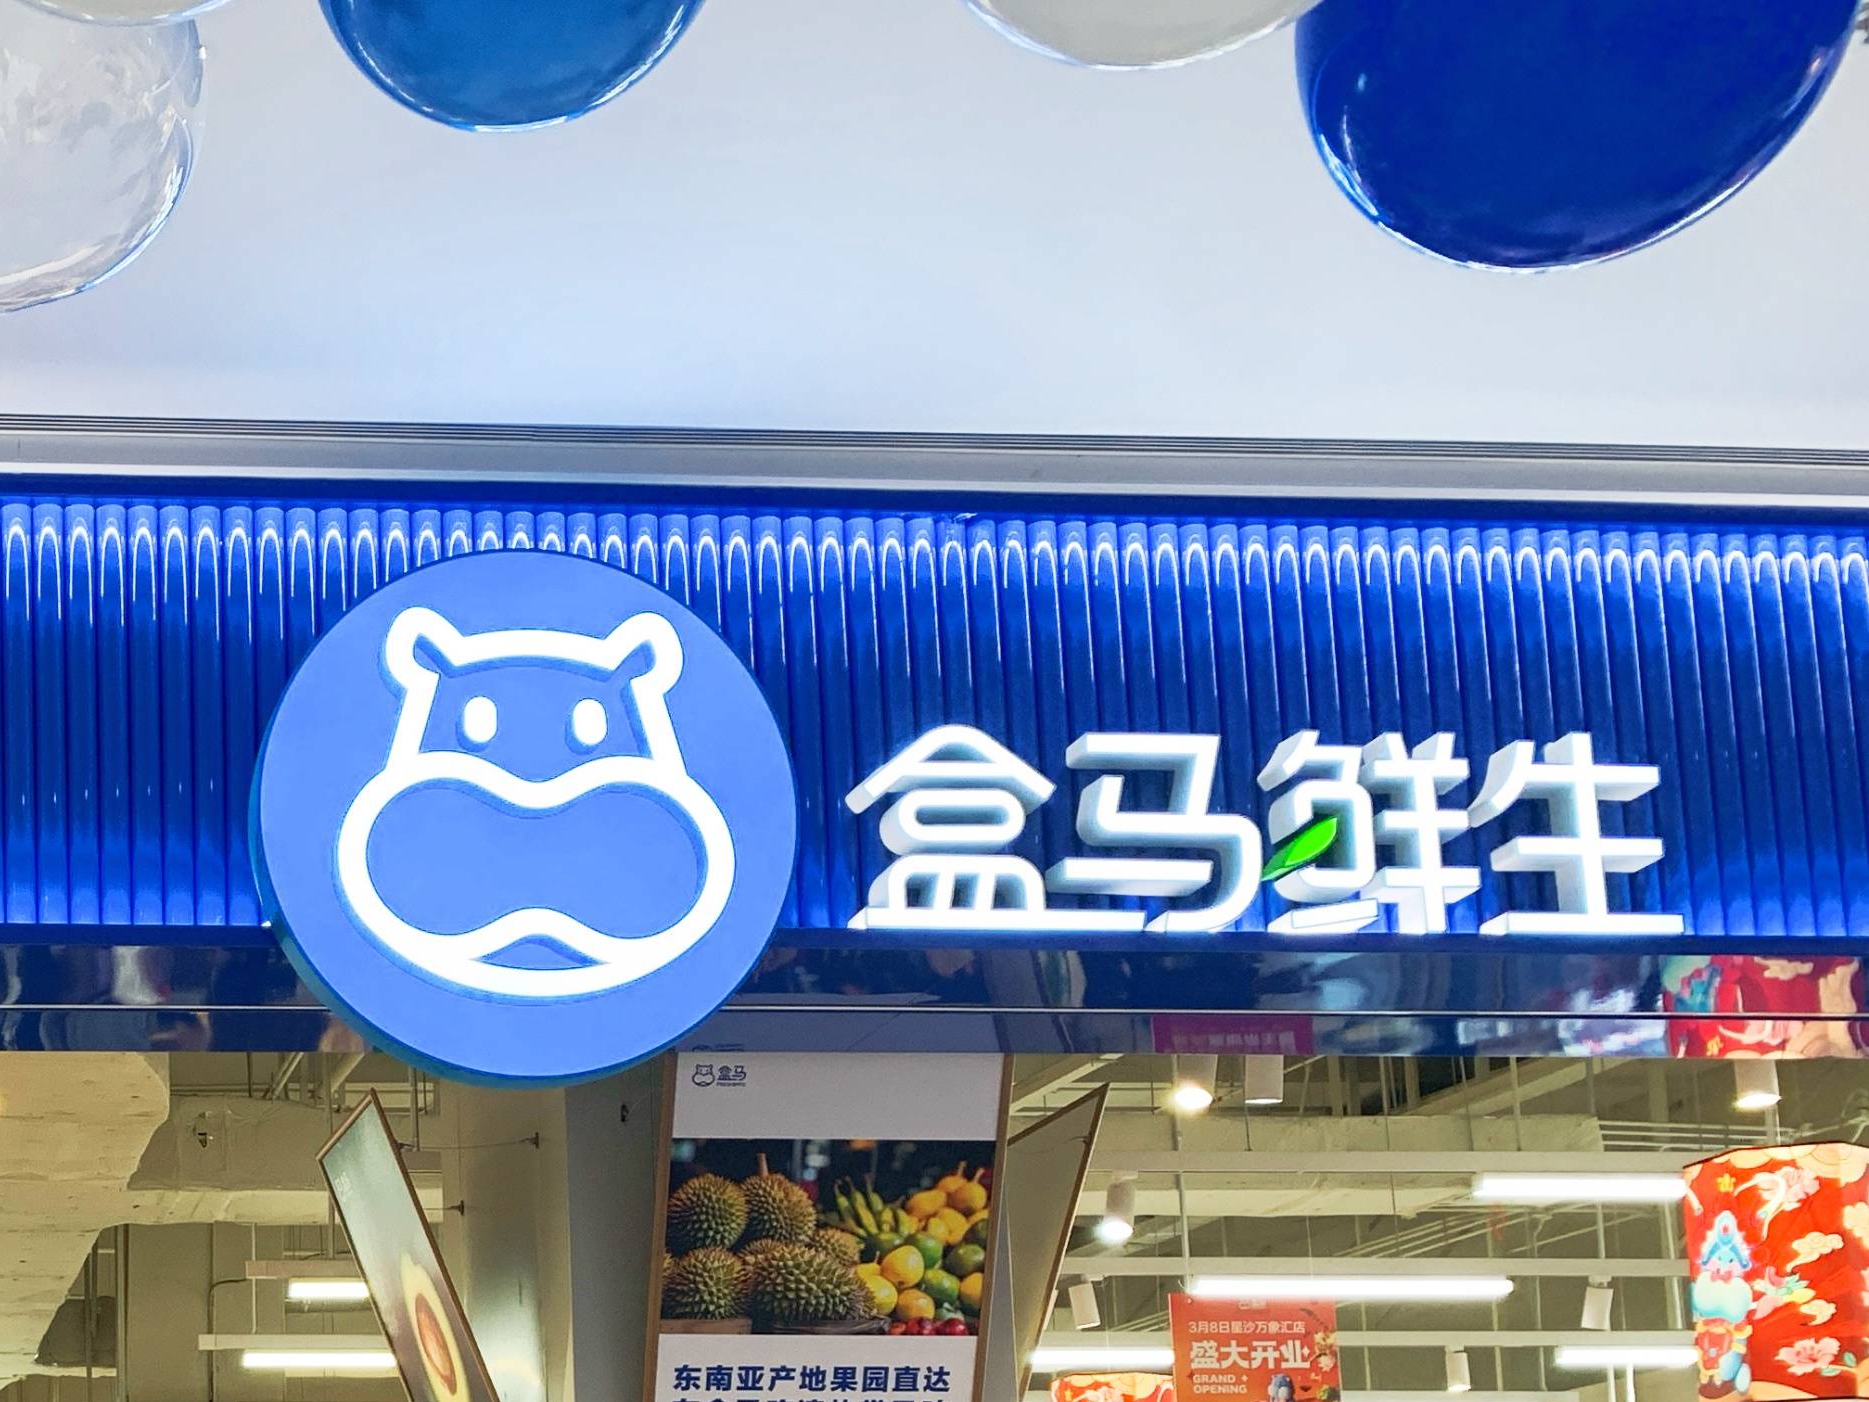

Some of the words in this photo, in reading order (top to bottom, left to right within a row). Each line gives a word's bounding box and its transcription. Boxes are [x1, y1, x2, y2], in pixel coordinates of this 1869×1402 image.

[845, 724, 1686, 935] 盒马鲜生
[718, 1065, 746, 1080] 盒马
[1189, 1321, 1306, 1334] 3月8日星沙万象汇店
[1190, 1339, 1311, 1370] 盛大开业
[673, 1365, 950, 1392] 东南亚产地果园直达
[1193, 1374, 1236, 1384] GRAND
[1193, 1384, 1248, 1394] OPENING
